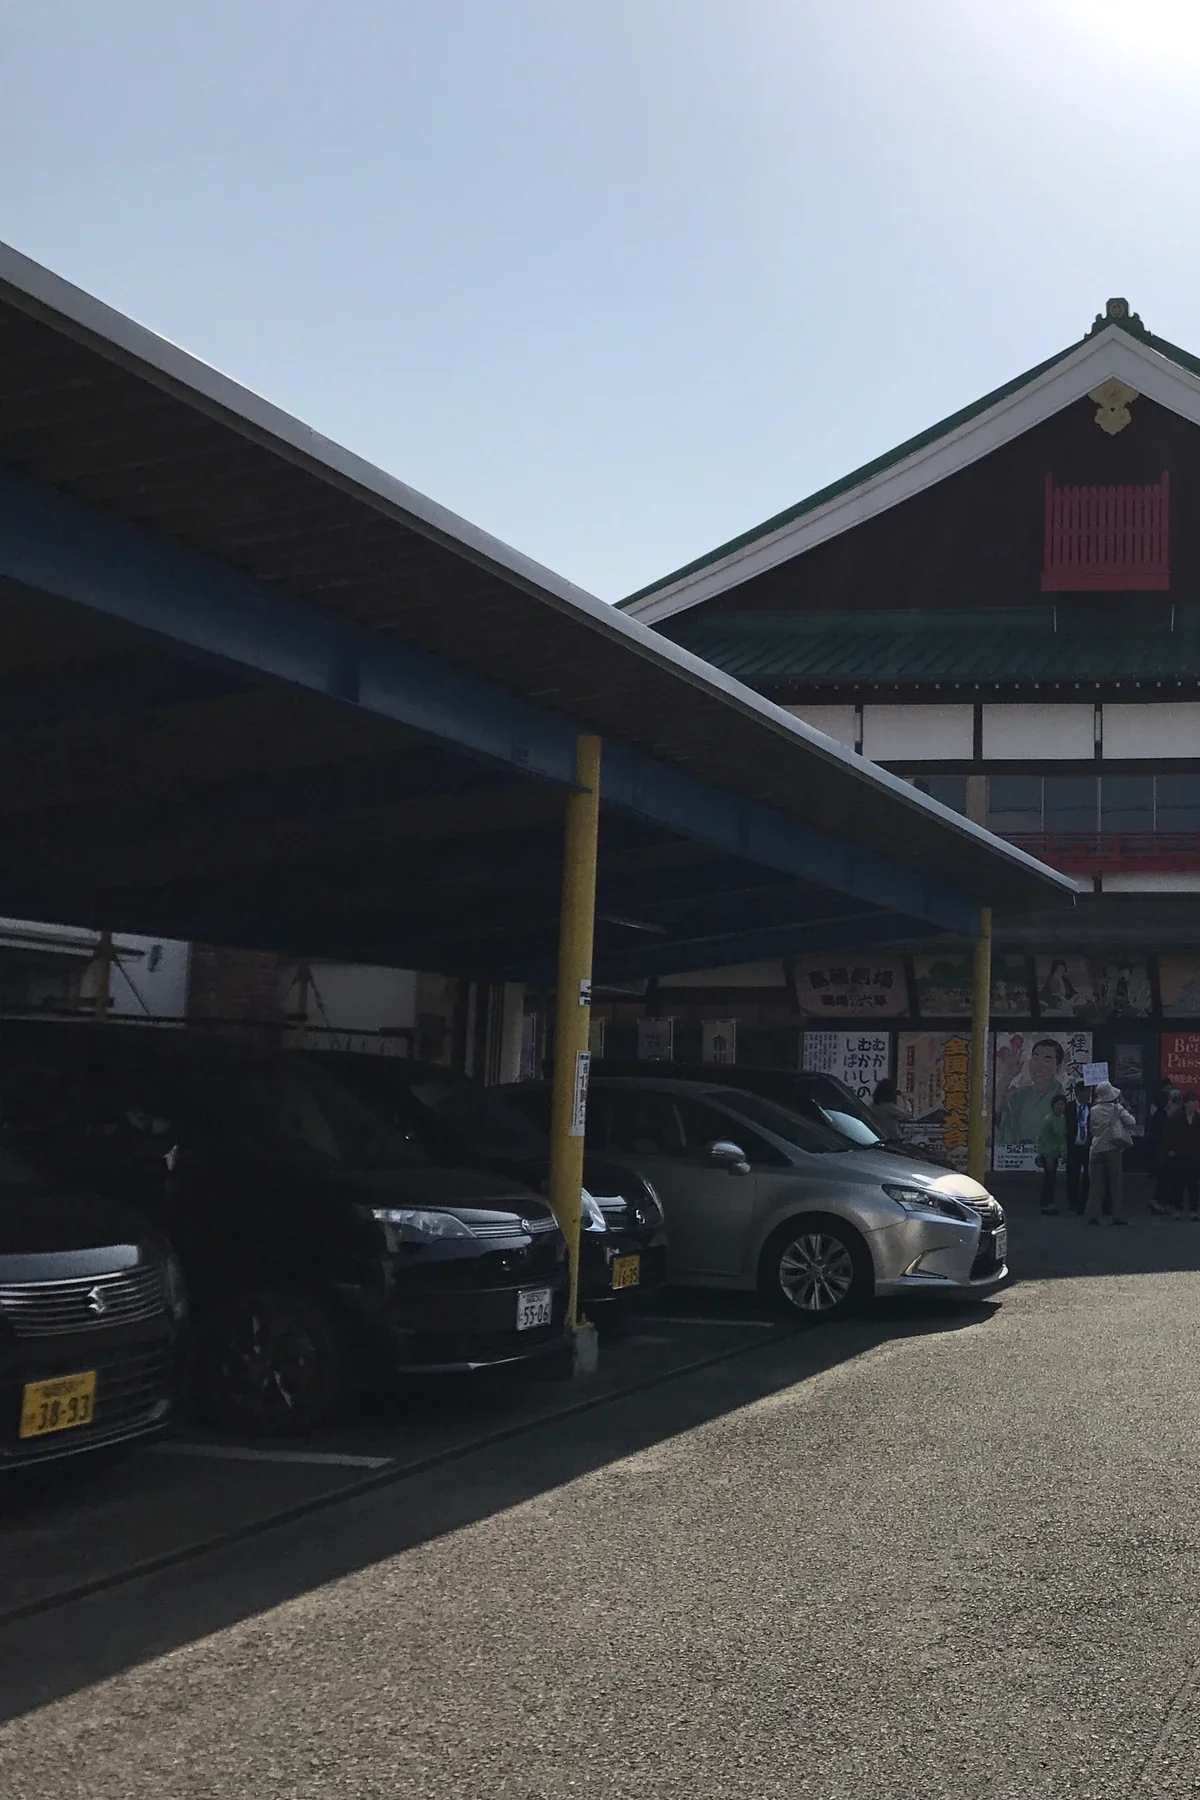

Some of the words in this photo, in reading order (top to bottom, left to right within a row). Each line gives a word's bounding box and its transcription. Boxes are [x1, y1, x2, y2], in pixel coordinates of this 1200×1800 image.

[857, 1037, 872, 1098] むかしの
[523, 1304, 549, 1326] 55-06
[37, 1393, 90, 1431] 38-93
